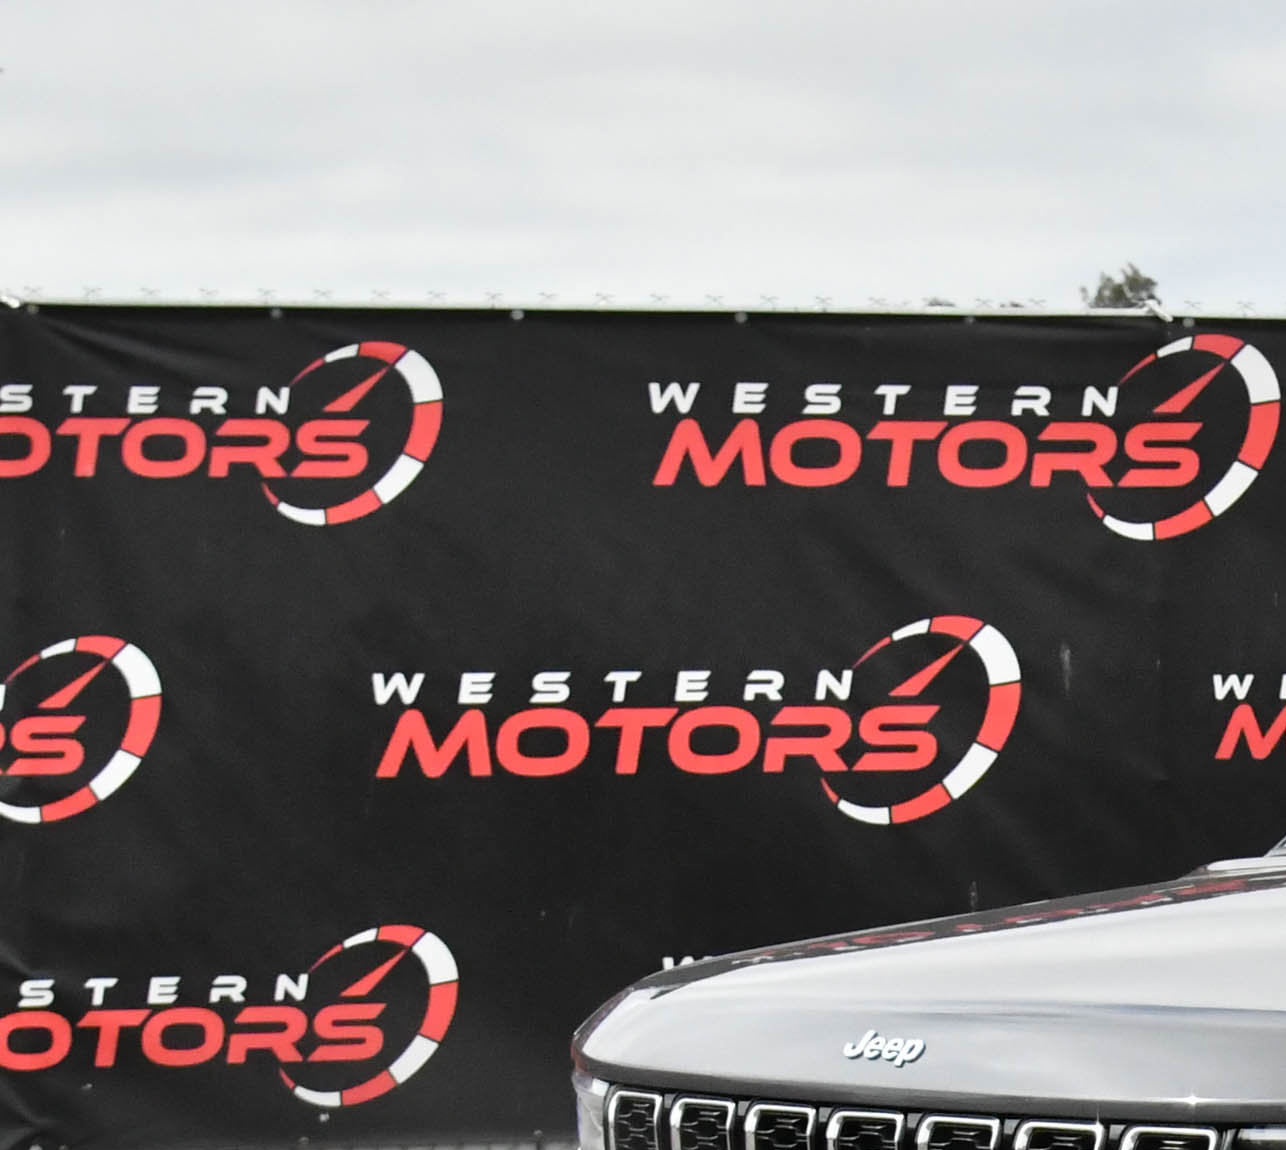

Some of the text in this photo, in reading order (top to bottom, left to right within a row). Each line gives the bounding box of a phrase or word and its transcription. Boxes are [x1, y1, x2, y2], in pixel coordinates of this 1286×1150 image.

[648, 382, 1119, 416] WESTERN
[652, 418, 1203, 487] MOTORS
[372, 669, 853, 705] WESTERN
[375, 705, 940, 777] MOTORS
[843, 1029, 925, 1068] Jeep
